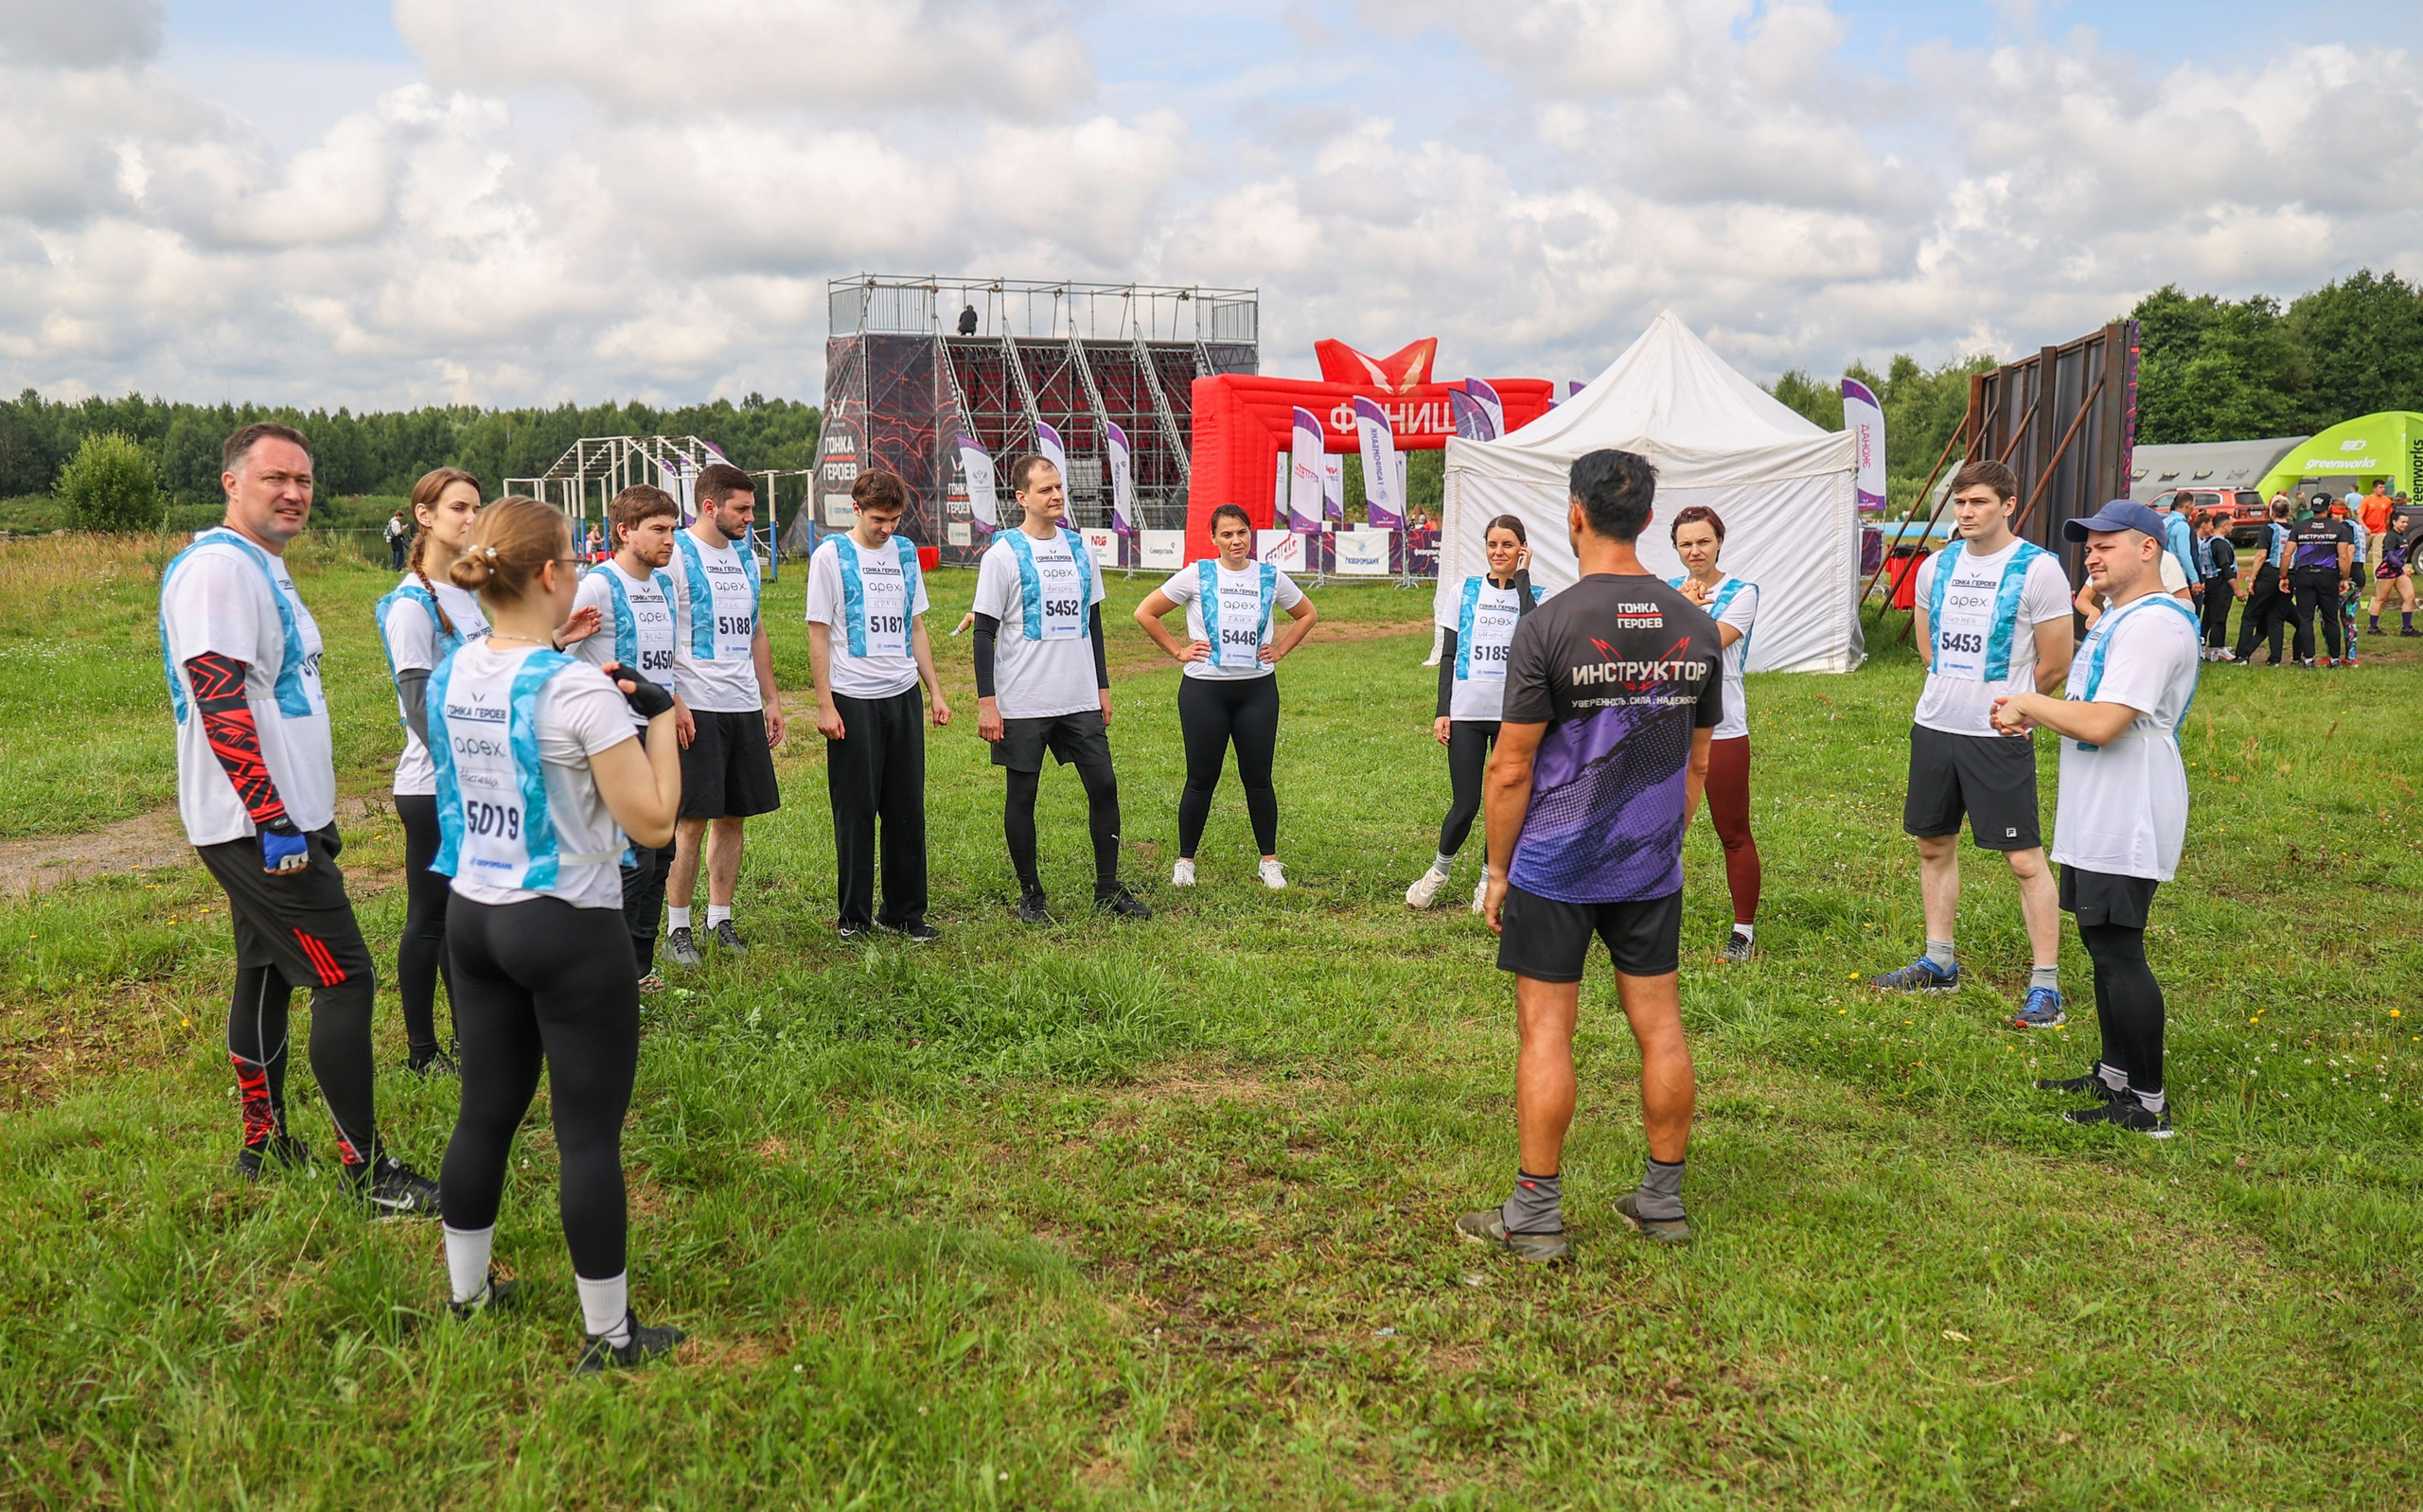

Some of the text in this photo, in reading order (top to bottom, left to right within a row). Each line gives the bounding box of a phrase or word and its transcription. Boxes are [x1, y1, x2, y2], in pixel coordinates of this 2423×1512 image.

[1329, 402, 1457, 434] ФНИШ
[824, 435, 855, 454] ГОНКА
[822, 463, 858, 481] ГЕРОЕВ
[2305, 457, 2378, 470] greenworks
[2409, 438, 2423, 506] reenworks
[1043, 569, 1073, 579] apex
[715, 581, 746, 592] apex
[869, 582, 900, 593] apex
[1046, 600, 1079, 617] 5452
[1223, 601, 1257, 610] apex
[1618, 602, 1659, 614] ГОНКА
[1950, 596, 1989, 608] apex
[639, 611, 668, 624] apex
[719, 617, 751, 635] 5188
[871, 615, 903, 634] 5187
[1479, 616, 1514, 626] apex
[1617, 618, 1663, 629] ГЕРОЕВ
[1222, 629, 1257, 646] 5446
[1941, 632, 1982, 653] 5453
[643, 650, 673, 670] 5450
[1474, 645, 1510, 660] 5185
[1572, 660, 1707, 686] ИНСТРУКТОР
[447, 704, 506, 719] ГОНКА ГЕРОЕВ
[453, 736, 503, 759] apex
[467, 800, 519, 840] 5019
